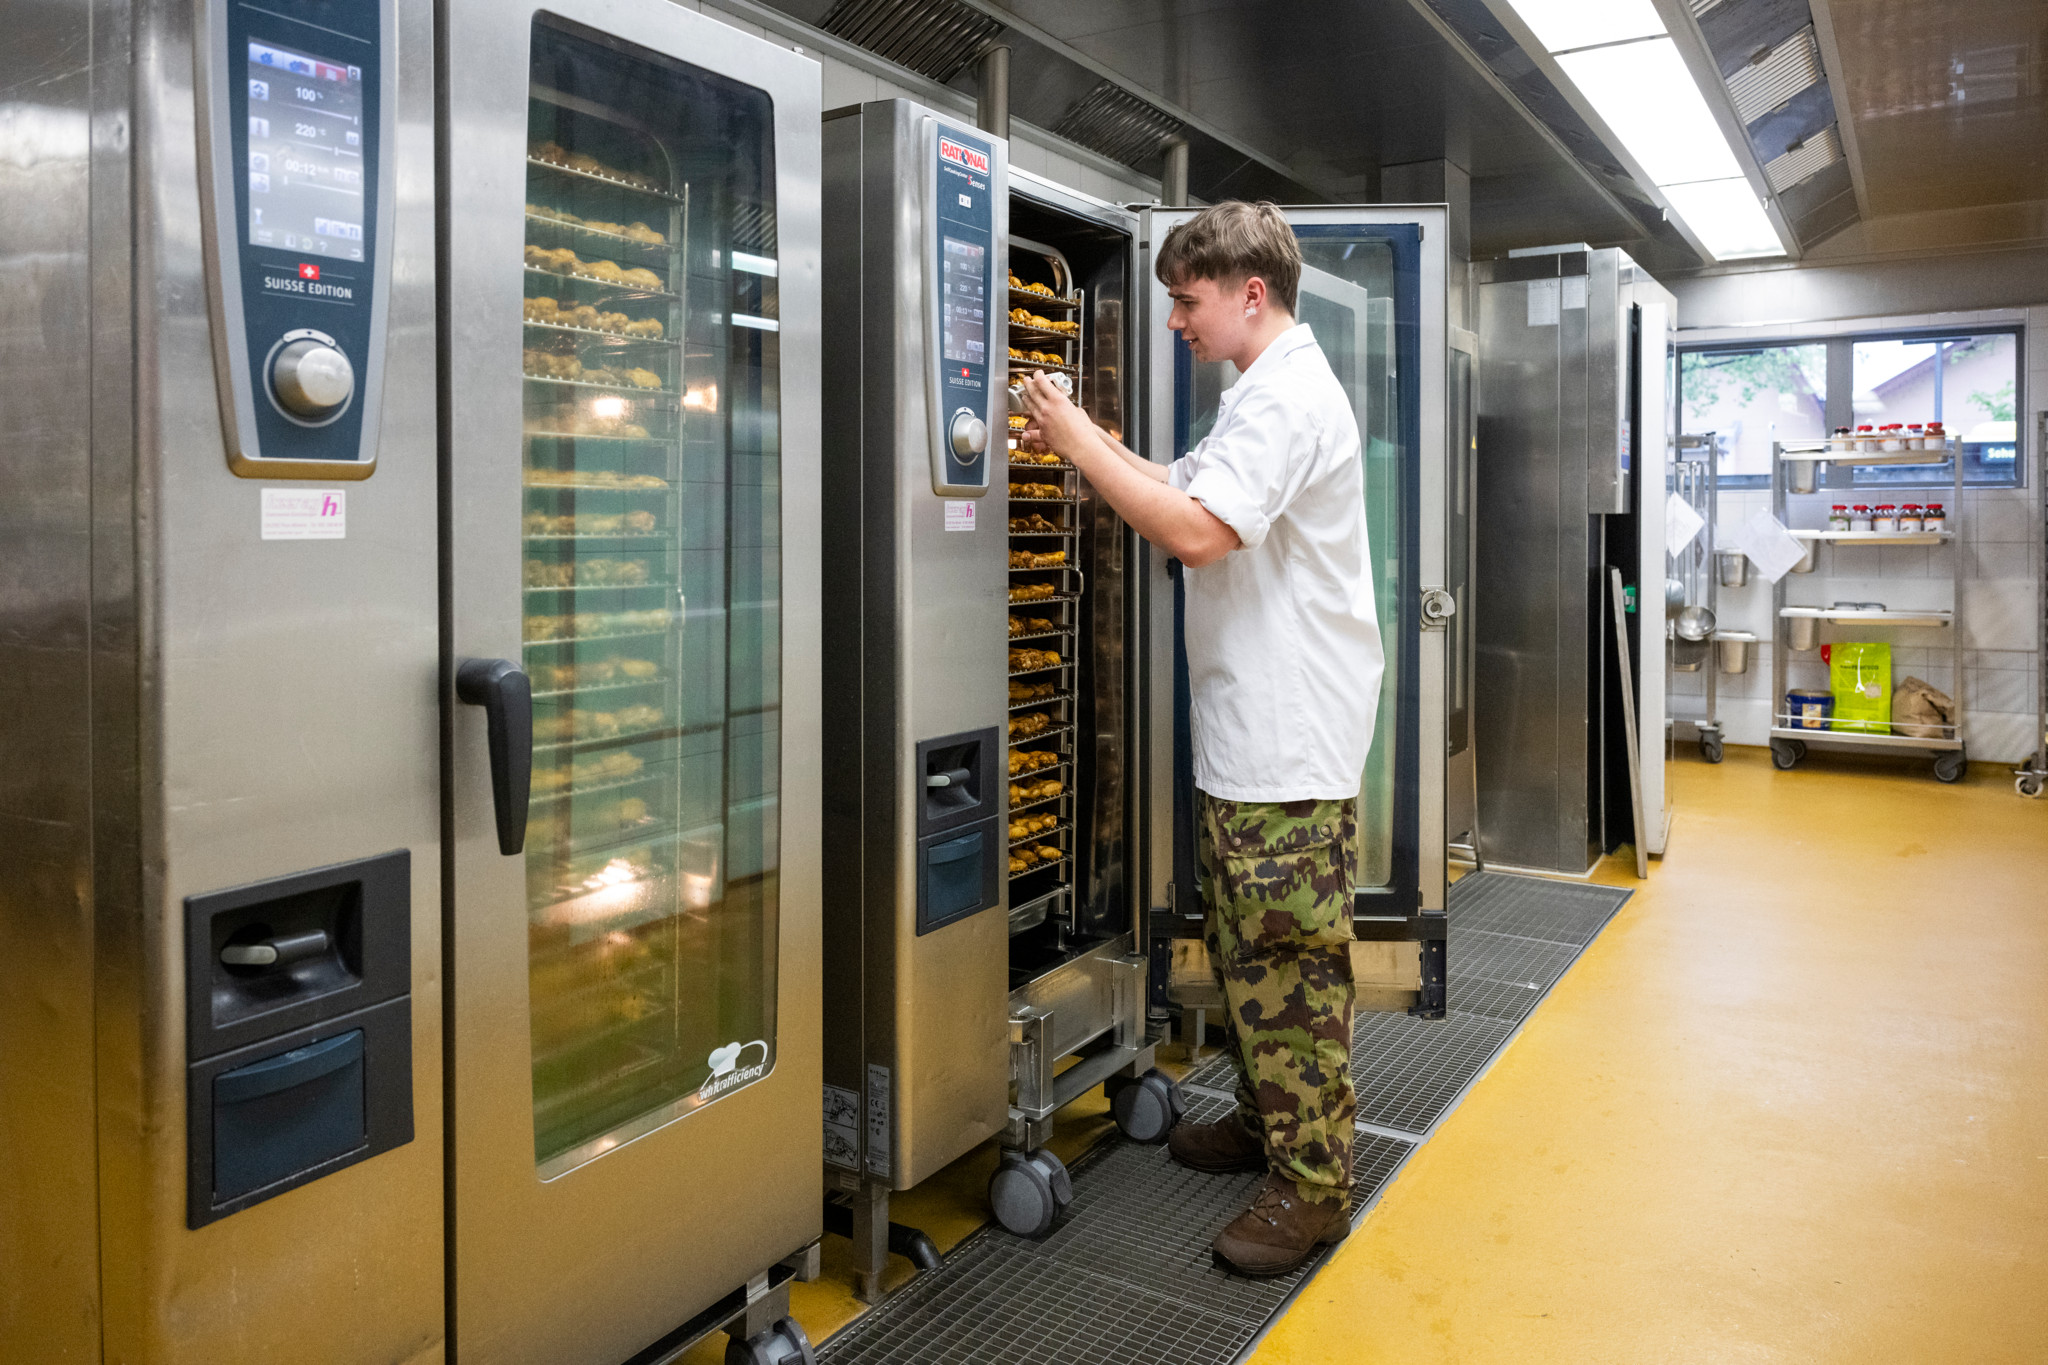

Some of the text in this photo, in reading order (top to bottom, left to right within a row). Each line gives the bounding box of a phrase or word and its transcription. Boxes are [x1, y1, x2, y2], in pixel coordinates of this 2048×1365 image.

[295, 86, 316, 101] 100
[295, 122, 316, 138] 220
[941, 141, 988, 172] RATIONAL
[285, 159, 316, 176] 00:12
[265, 276, 353, 299] SUISSE EDITION
[949, 376, 982, 388] SUISSE EDITION
